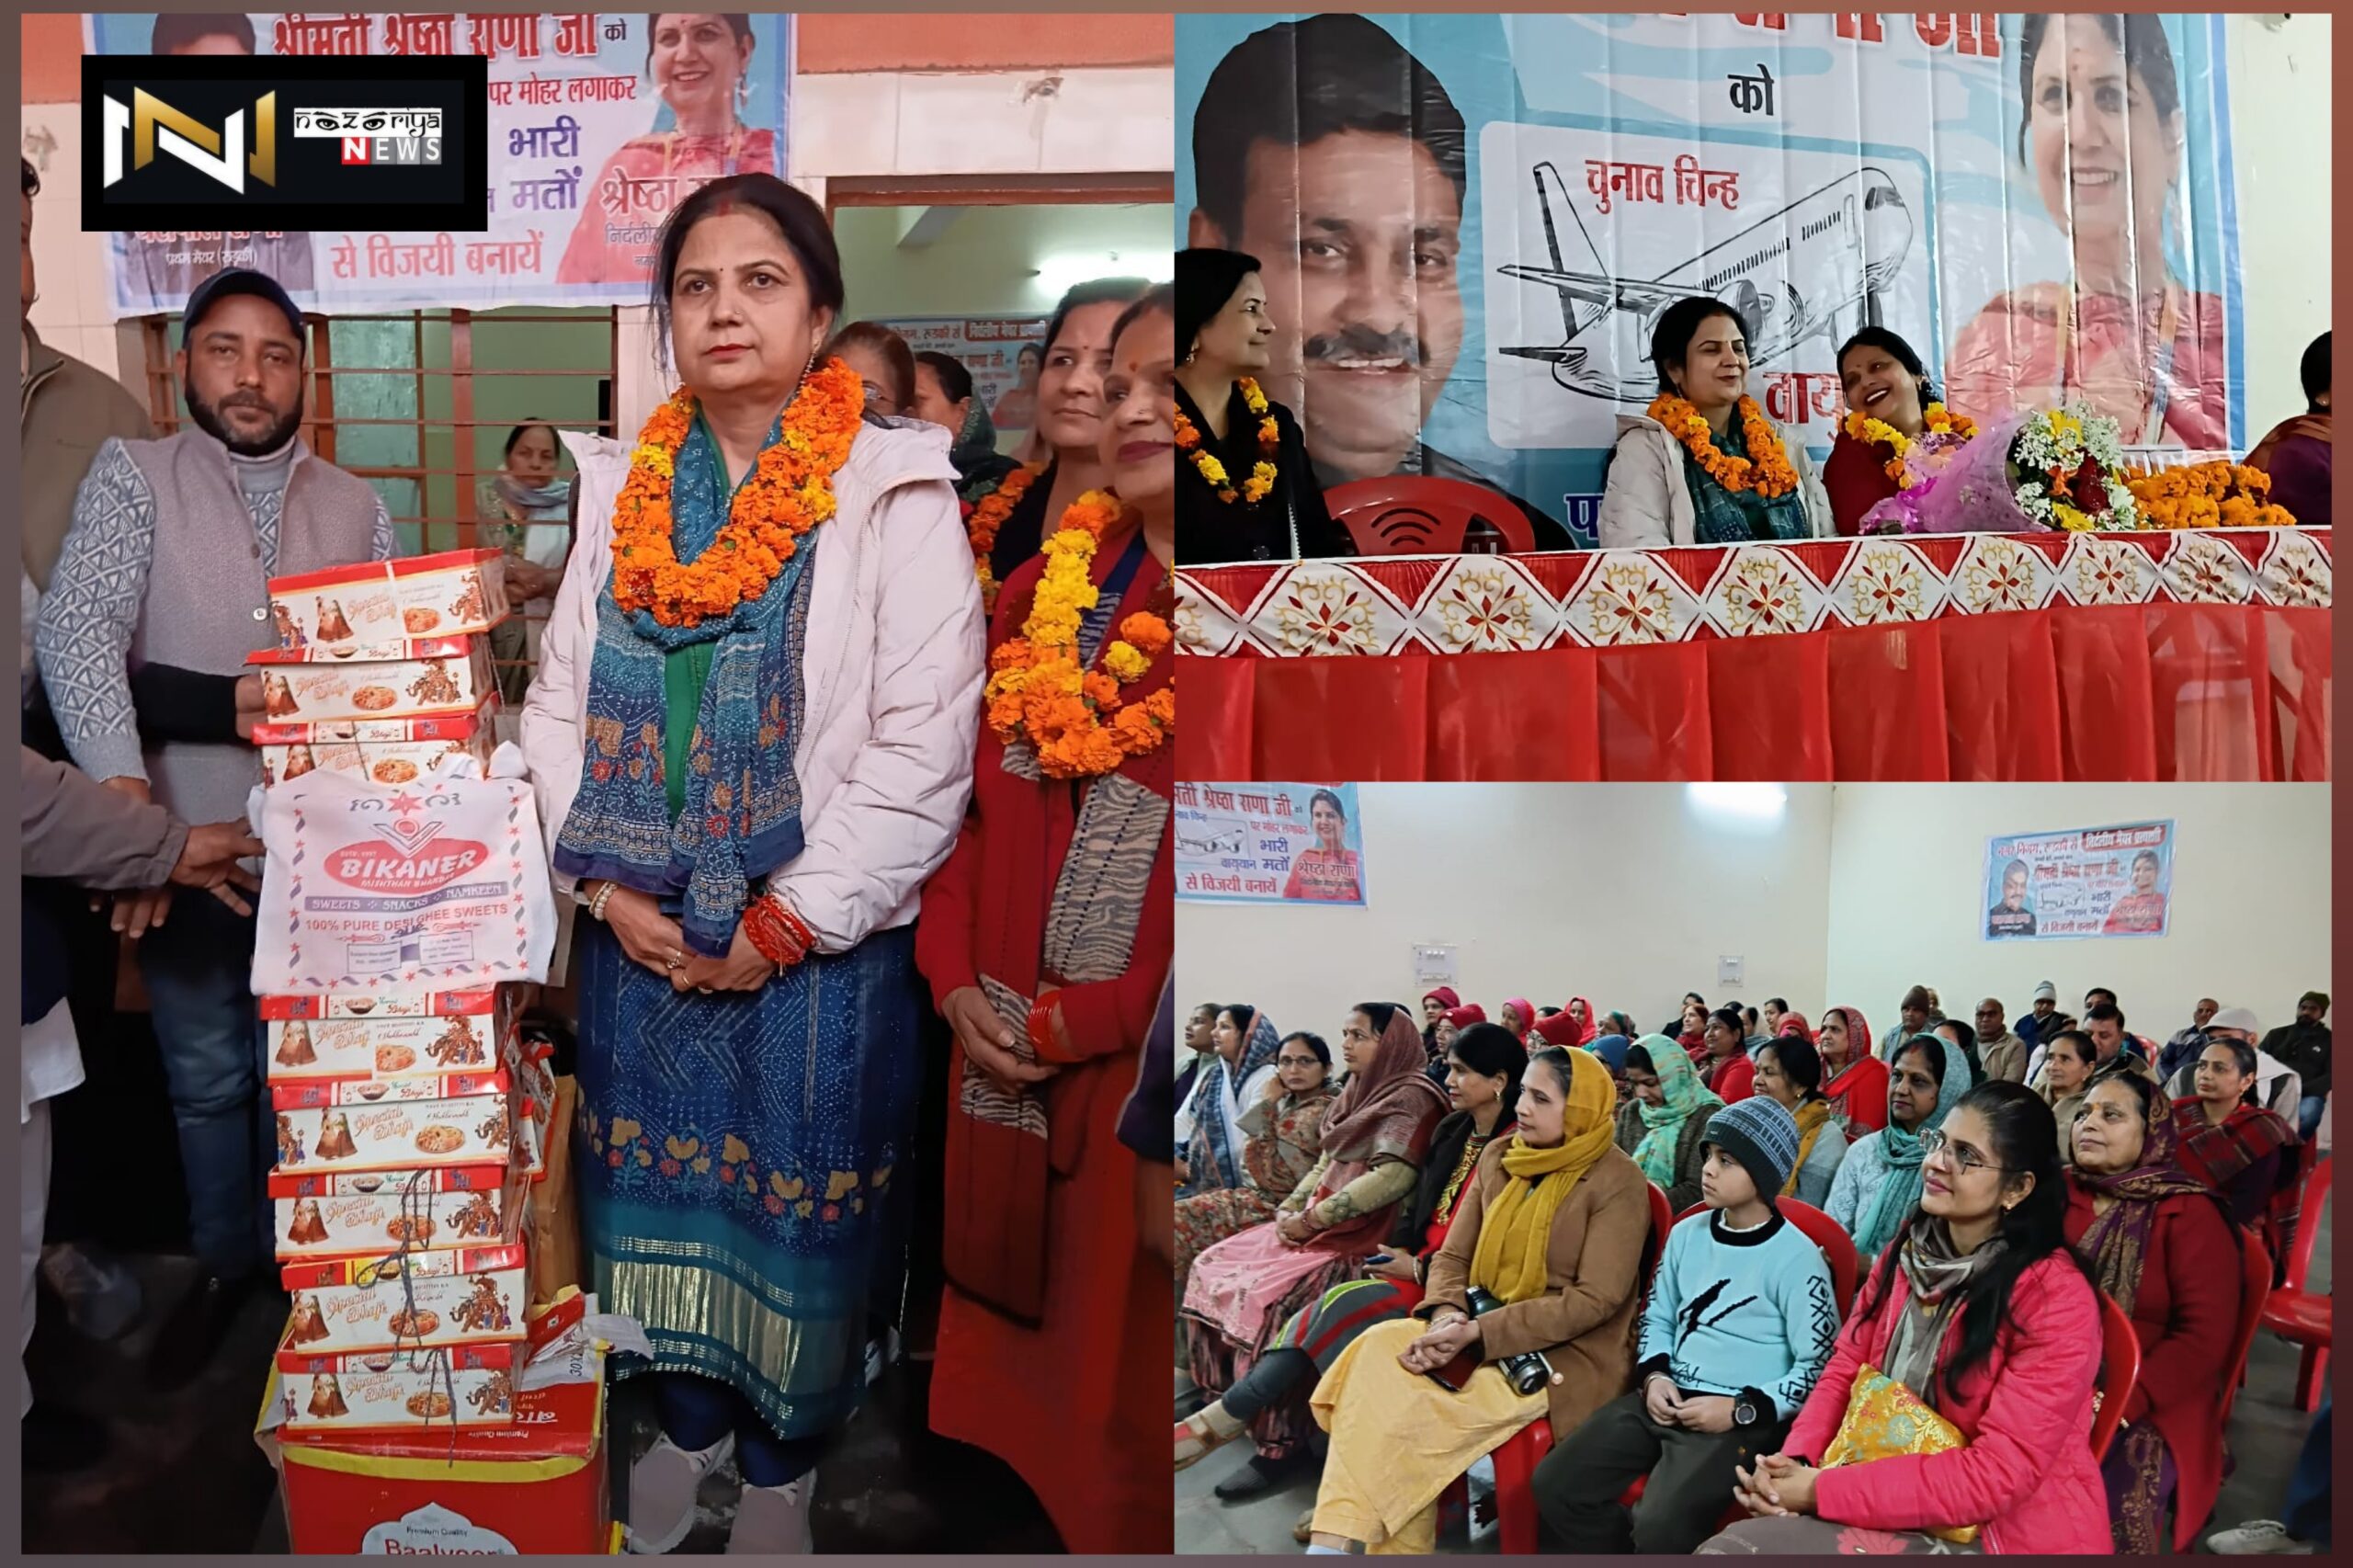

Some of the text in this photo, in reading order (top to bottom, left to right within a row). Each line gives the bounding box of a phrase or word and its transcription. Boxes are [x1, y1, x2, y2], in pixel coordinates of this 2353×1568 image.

[604, 18, 627, 41] को
[489, 73, 638, 106] पर मोहर लगाकर
[1727, 63, 1776, 116] को
[508, 114, 581, 158] भारी
[510, 165, 583, 210] मतों
[1585, 154, 1740, 215] चुनाव चिन्ह
[331, 230, 544, 278] से विजयी बनायें
[1238, 794, 1269, 815] राणा
[1273, 793, 1291, 817] जी
[1260, 837, 1289, 854] भारी
[340, 848, 477, 879] BIKANER
[1262, 857, 1290, 872] मतों
[1330, 864, 1356, 881] राणा
[1186, 872, 1278, 893] से विजयी बनायें
[312, 884, 503, 911] SWEETS SNACKS NAMKEEN
[305, 920, 338, 932] 100%
[343, 919, 380, 932] PURE
[416, 907, 449, 924] GHEE
[454, 903, 509, 918] SWEETS
[406, 1526, 468, 1537] Premium Quality
